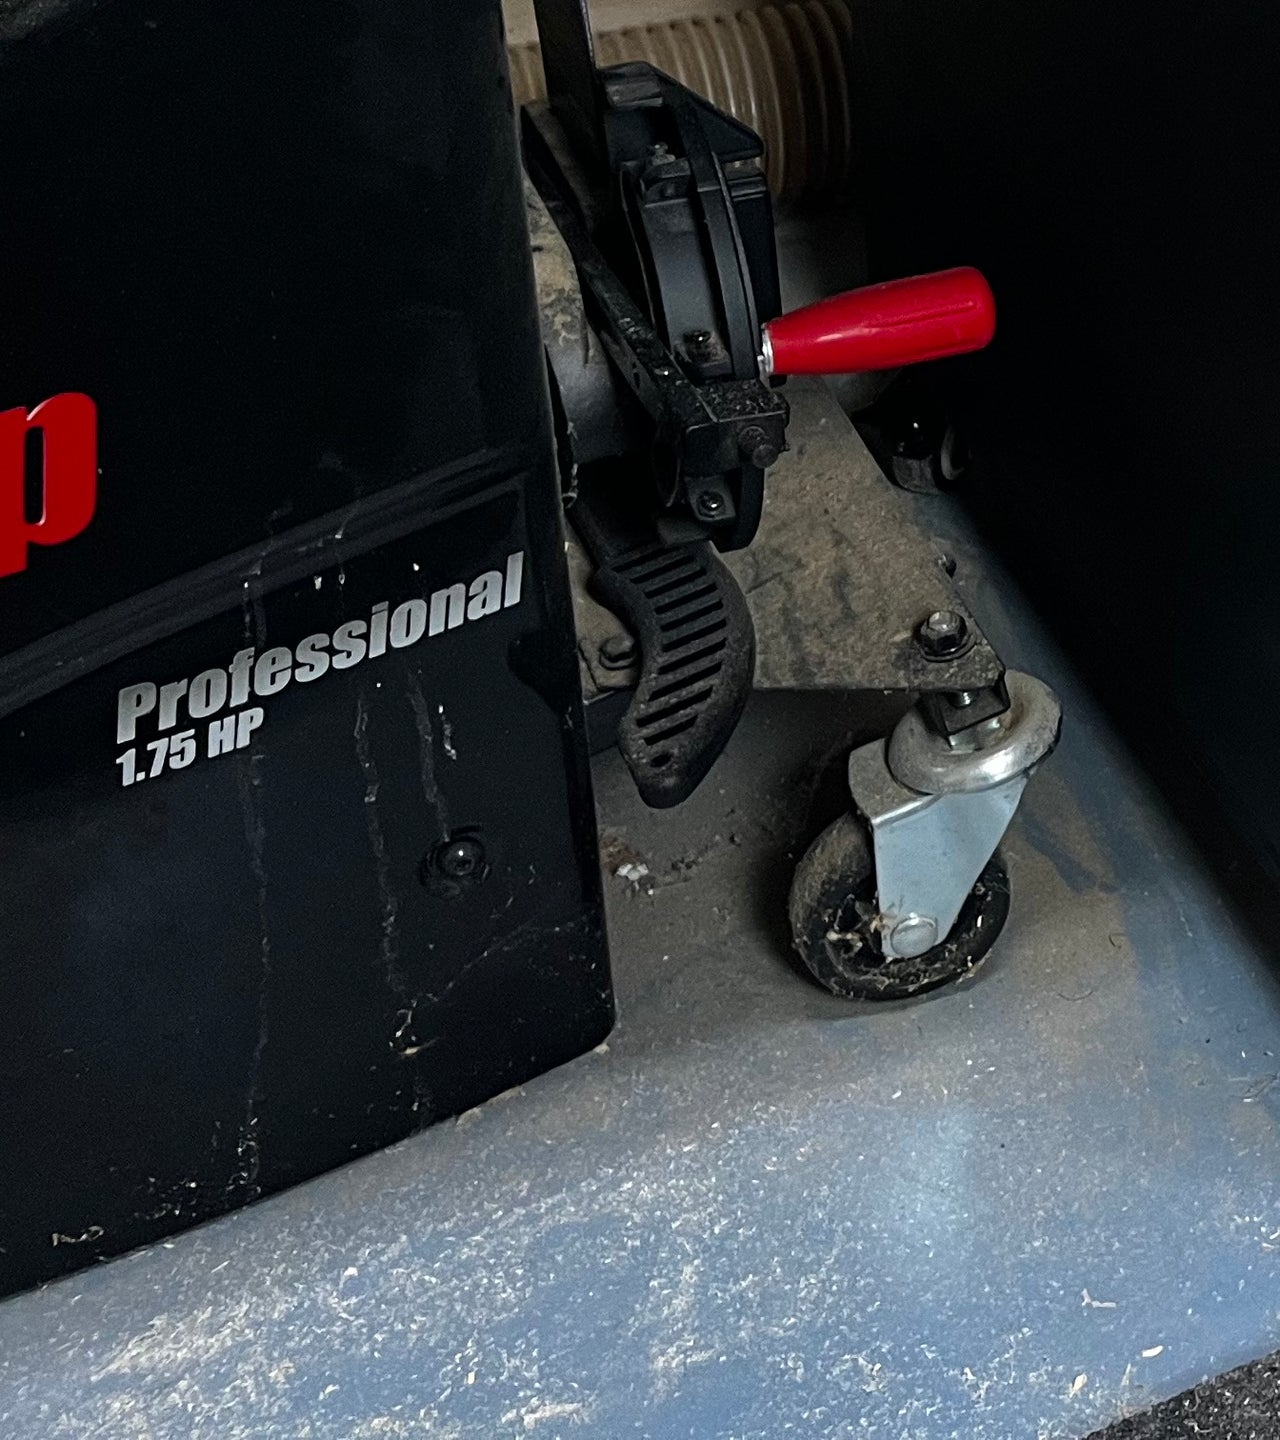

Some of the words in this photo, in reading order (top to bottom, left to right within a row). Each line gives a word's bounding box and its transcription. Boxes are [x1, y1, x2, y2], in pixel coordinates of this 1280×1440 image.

[115, 550, 526, 744] Professional
[114, 726, 197, 788] 1.75
[207, 706, 265, 760] HP
